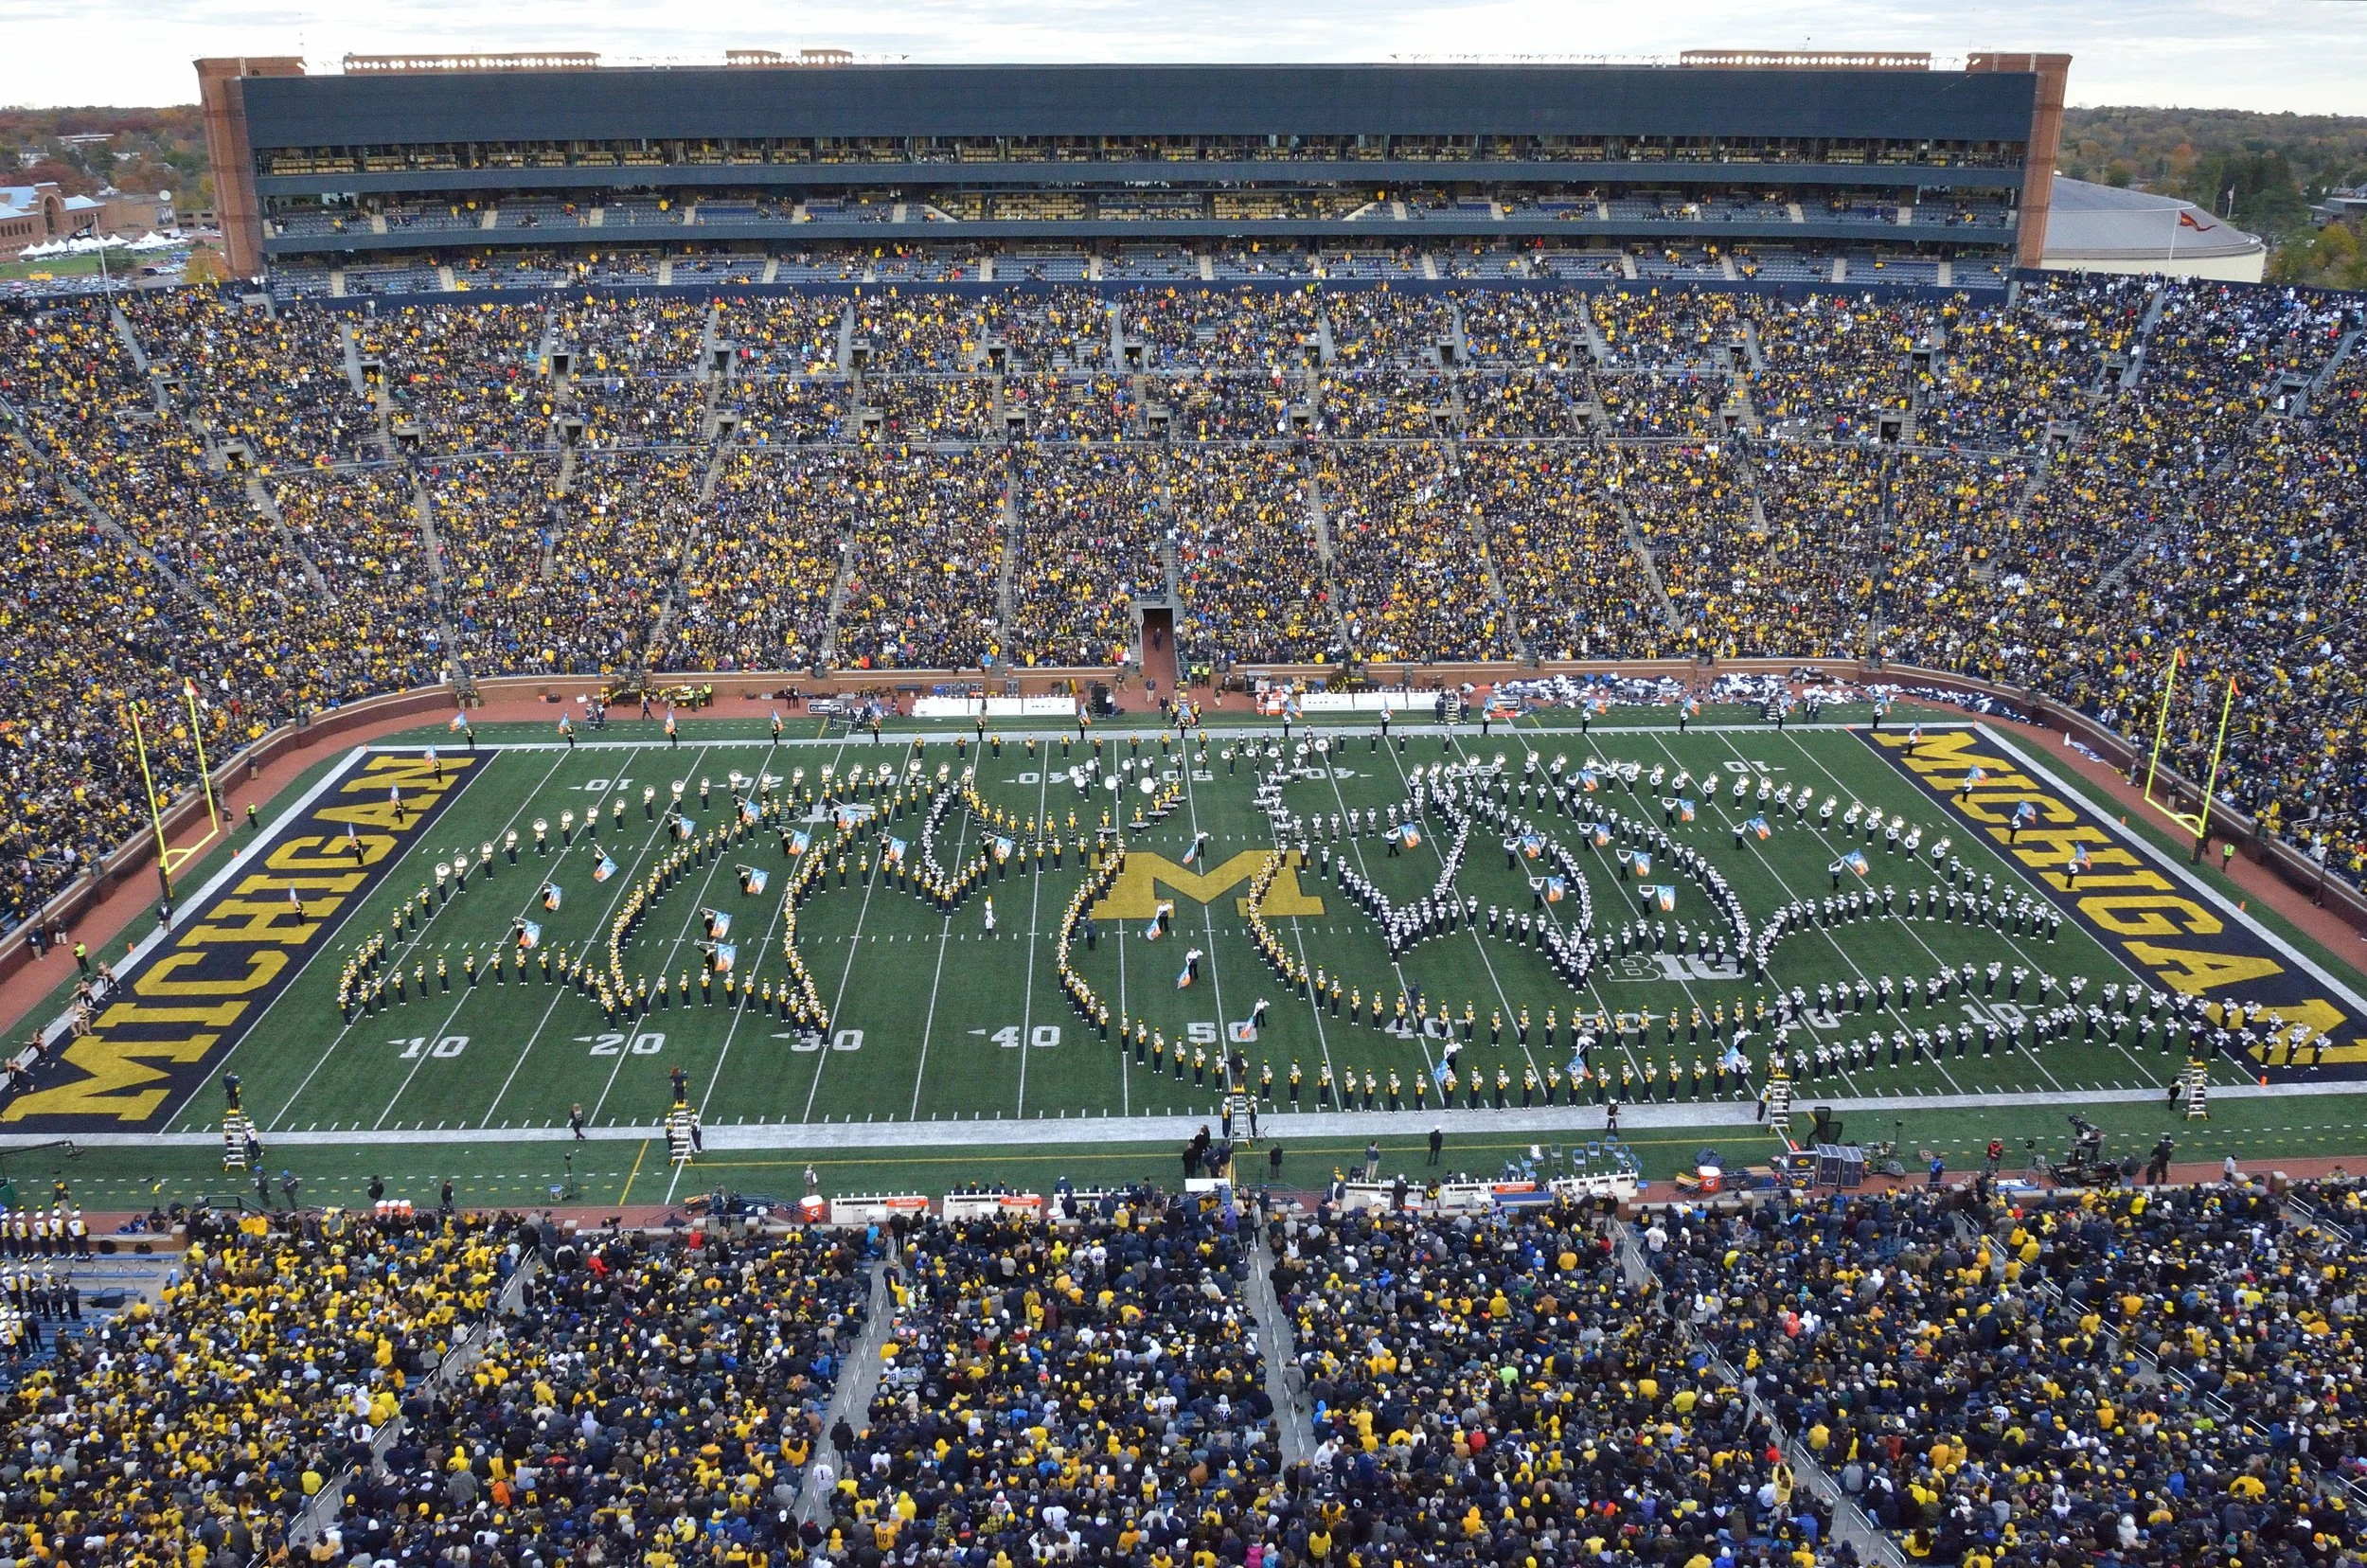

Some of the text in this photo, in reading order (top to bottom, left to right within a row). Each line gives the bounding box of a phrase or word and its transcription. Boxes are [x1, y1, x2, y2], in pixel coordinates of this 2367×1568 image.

[1019, 773, 1069, 784] 40
[1724, 761, 1777, 773] 10
[583, 778, 633, 792] 10
[1090, 848, 1325, 919] M
[1869, 732, 2367, 1066] MICHIGAN
[0, 755, 476, 1121] MICHIGAN
[1596, 953, 1747, 982] BIG
[1960, 1003, 2030, 1025] 10
[790, 1029, 864, 1052] 30
[990, 1025, 1061, 1048] 40
[1186, 1022, 1258, 1043] 50
[1384, 1018, 1455, 1040] 40
[399, 1036, 471, 1059] 10
[588, 1033, 666, 1056] 20
[877, 1532, 888, 1543] 10
